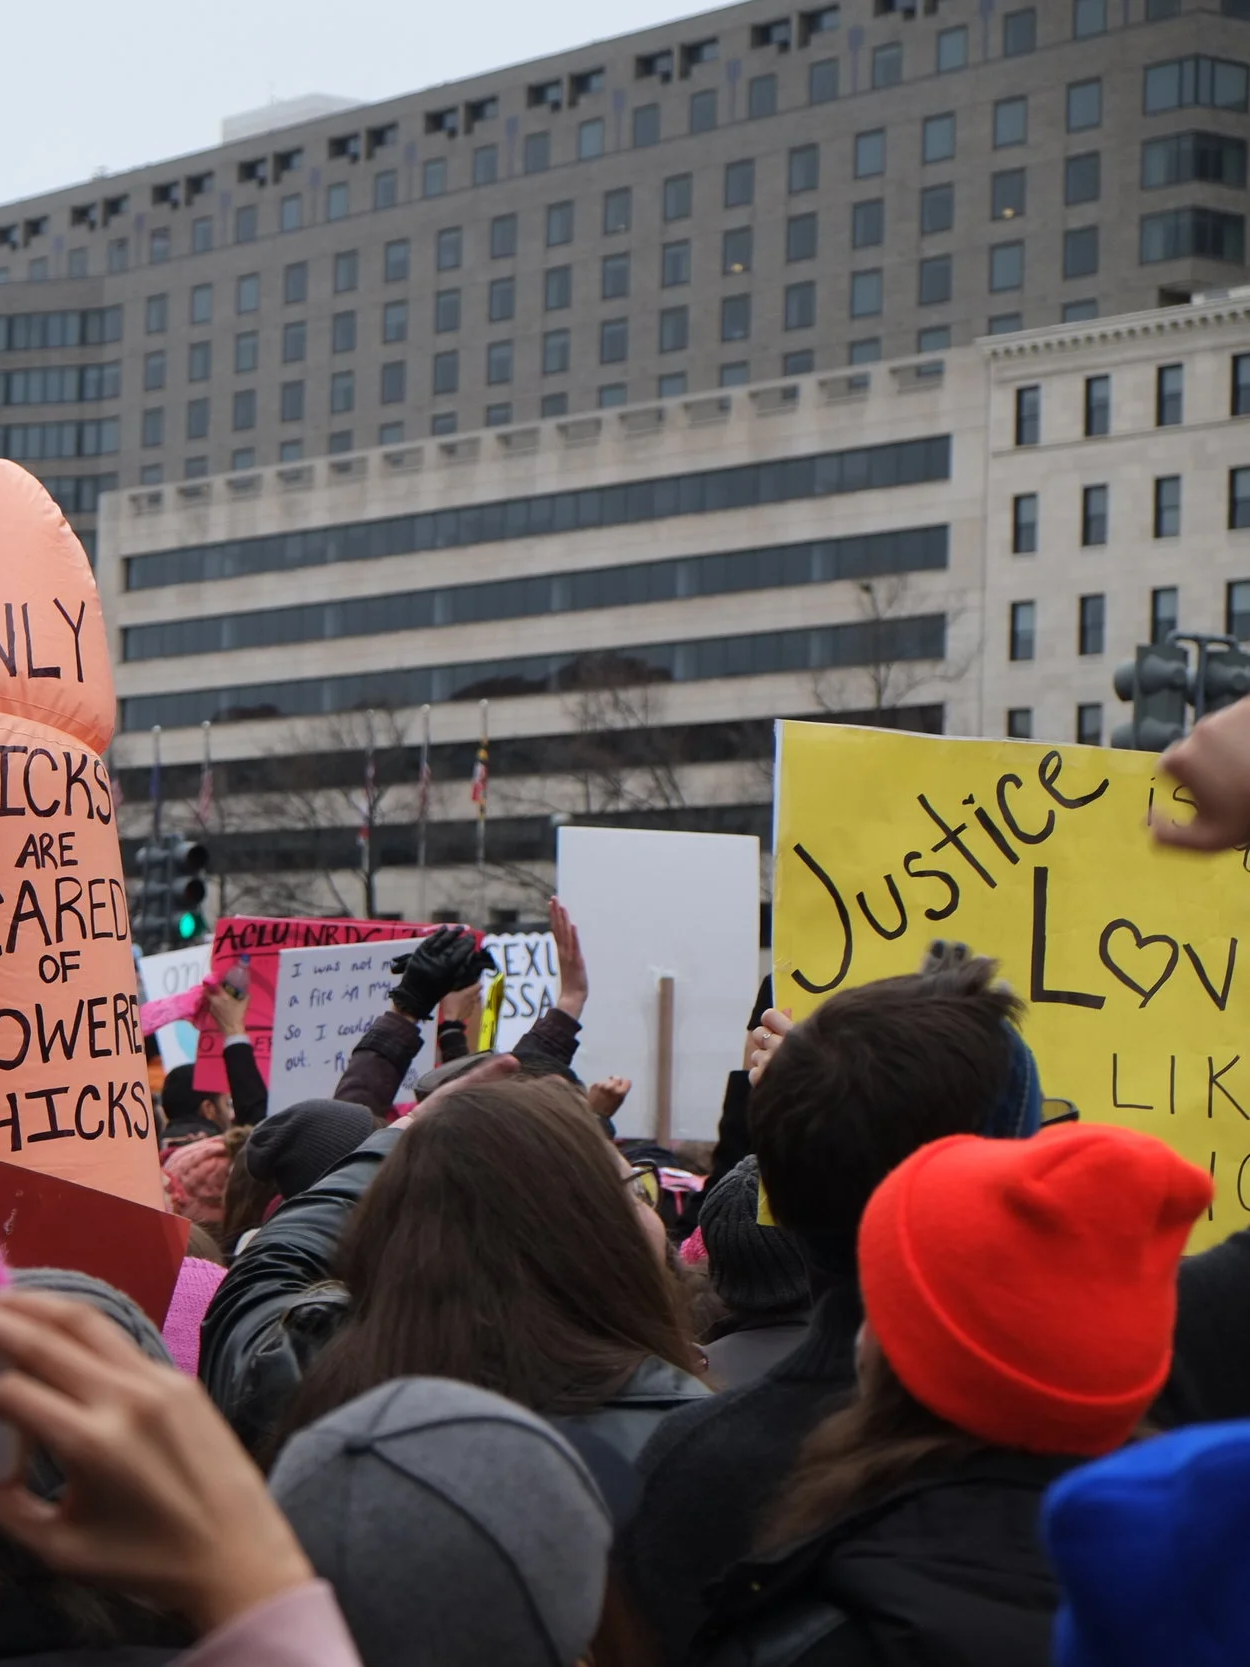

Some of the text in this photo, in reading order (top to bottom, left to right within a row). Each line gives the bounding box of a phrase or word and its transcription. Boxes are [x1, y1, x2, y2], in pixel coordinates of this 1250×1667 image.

[14, 832, 79, 870] ARE
[791, 750, 1110, 994] Justice
[214, 922, 291, 954] ACLU
[39, 951, 81, 984] OF
[291, 962, 303, 978] I
[314, 961, 341, 975] was
[351, 956, 372, 972] not
[288, 994, 300, 1007] a
[309, 987, 333, 1008] fire
[341, 985, 360, 1001] in
[315, 1023, 327, 1041] I
